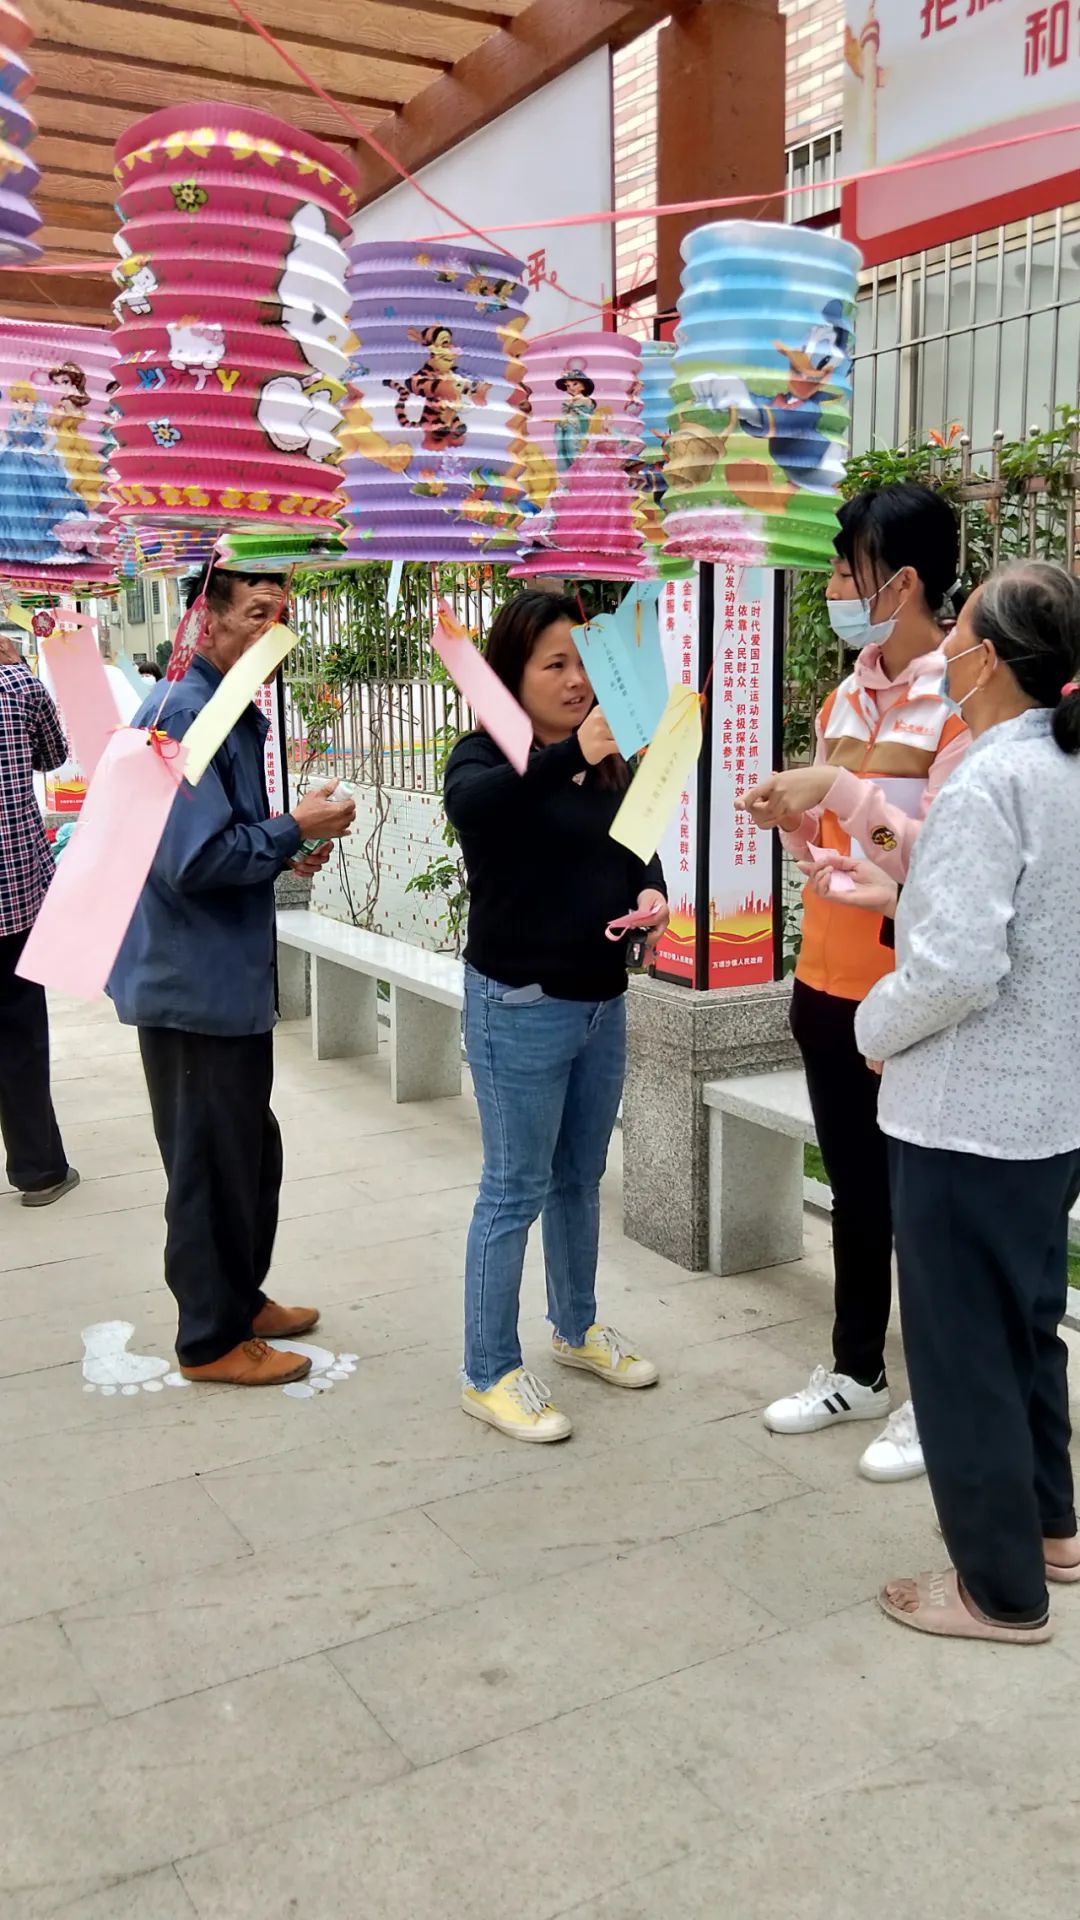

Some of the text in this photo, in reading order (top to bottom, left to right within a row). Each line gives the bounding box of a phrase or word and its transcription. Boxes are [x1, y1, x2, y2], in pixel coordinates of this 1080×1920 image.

[1024, 0, 1070, 77] 和
[735, 604, 749, 866] 依靠人民群众，积极探索更有效社会动员
